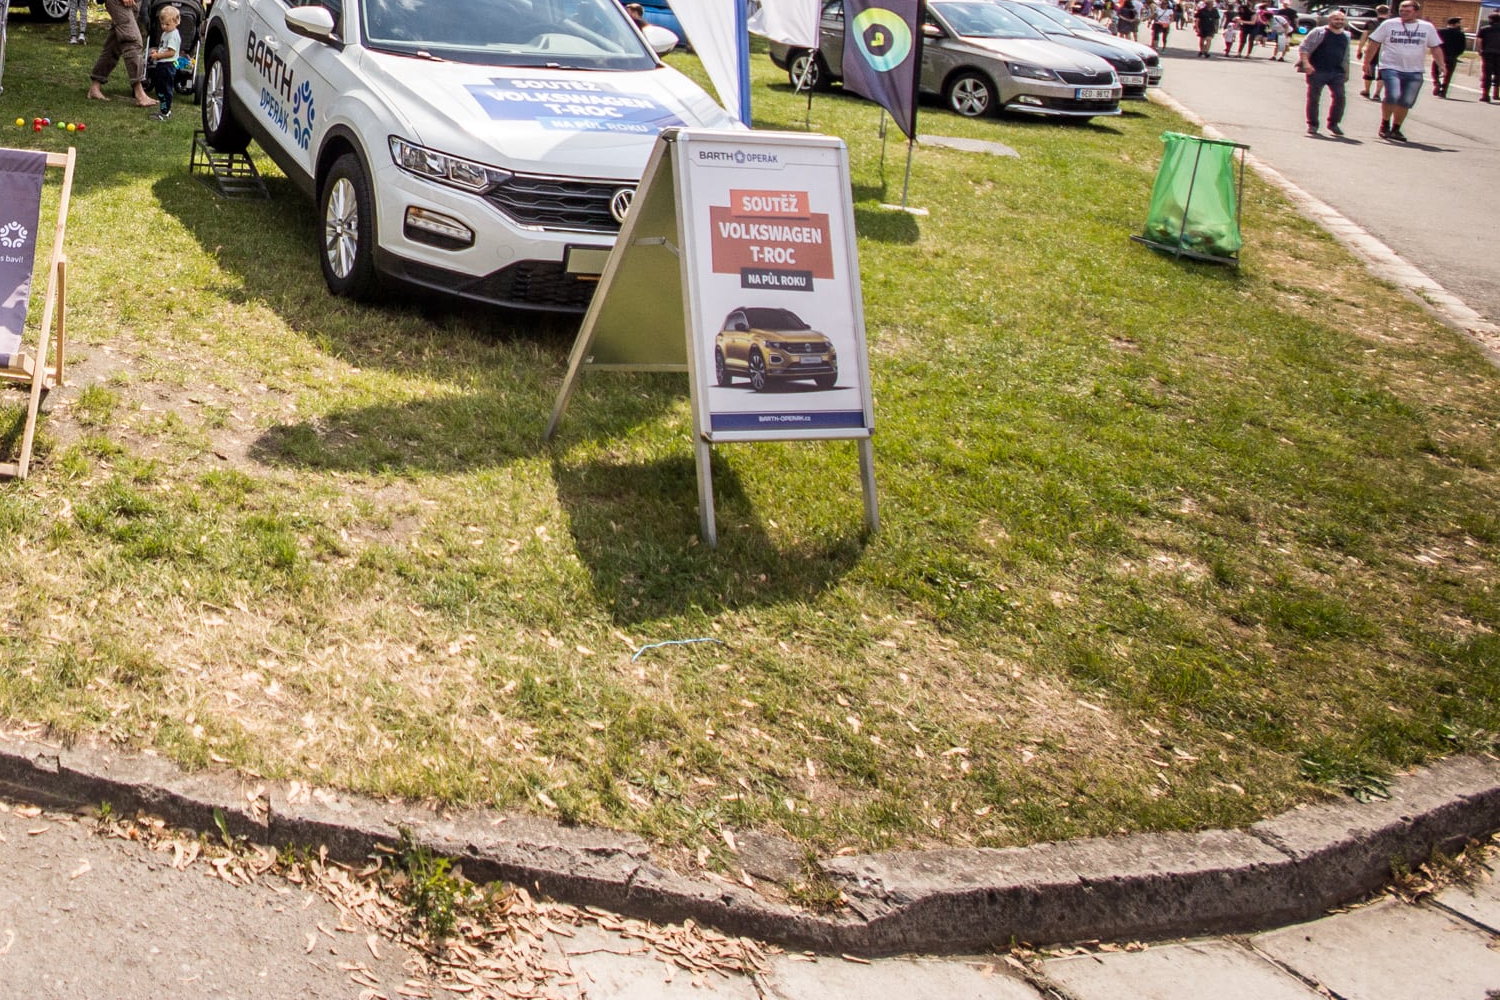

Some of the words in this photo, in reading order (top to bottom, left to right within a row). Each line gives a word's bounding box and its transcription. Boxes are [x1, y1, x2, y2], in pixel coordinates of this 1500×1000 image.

[246, 30, 293, 103] BARTH
[485, 89, 655, 109] VOLKSWAGEN
[260, 87, 289, 134] OPERÁK
[544, 103, 624, 118] T-ROC
[606, 121, 649, 133] ROKU
[699, 150, 734, 161] BARTH
[746, 151, 778, 163] OPERÁK
[742, 193, 799, 213] SOUTĚŽ
[718, 221, 822, 244] VOLKSWAGEN
[749, 246, 797, 264] T-ROC
[747, 274, 761, 285] NA
[762, 271, 780, 286] PŮL
[781, 276, 806, 287] ROKU
